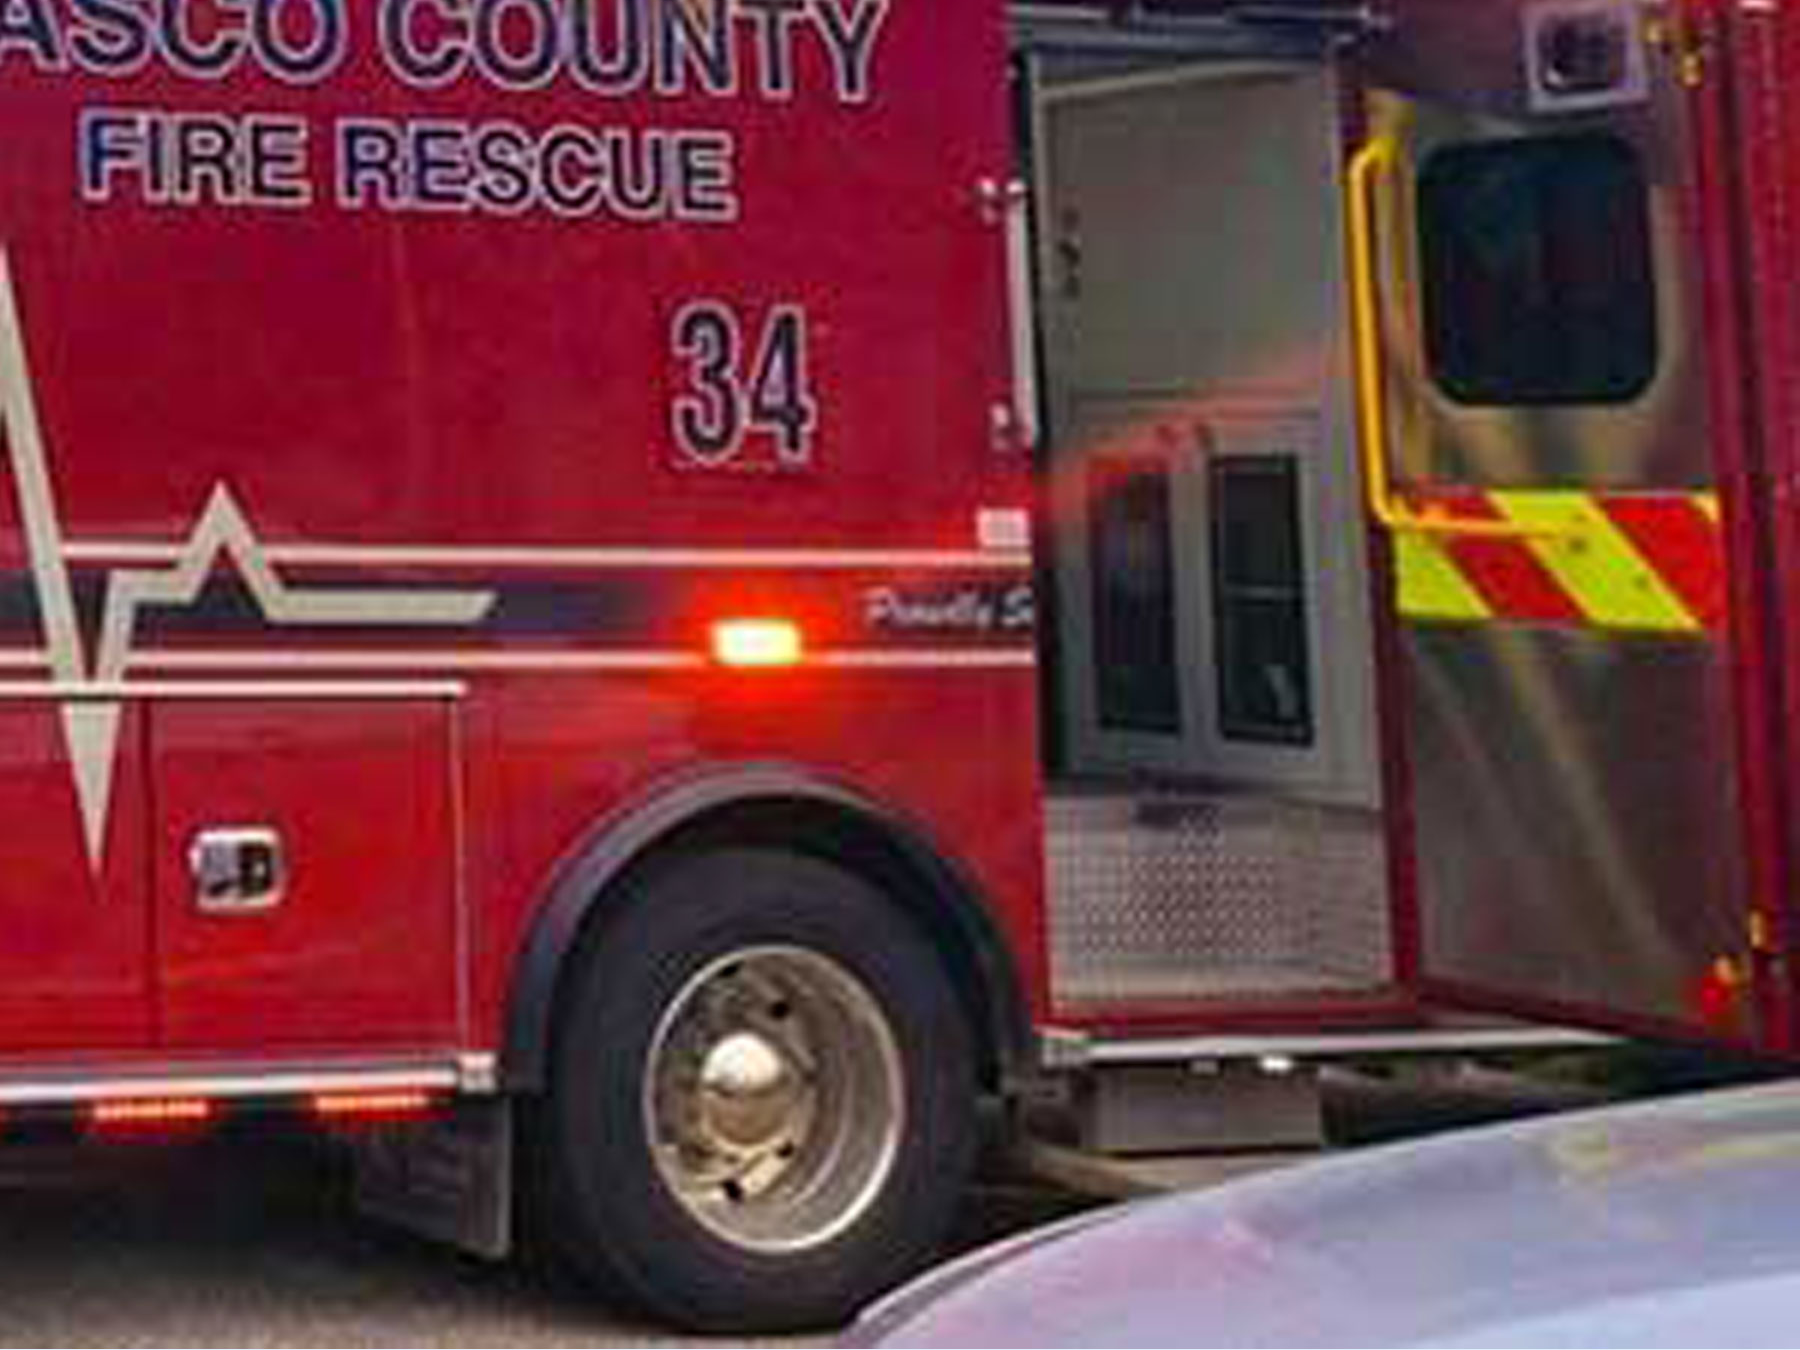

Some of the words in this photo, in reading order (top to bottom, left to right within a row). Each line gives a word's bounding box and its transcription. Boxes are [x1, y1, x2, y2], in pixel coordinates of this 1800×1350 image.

[79, 107, 312, 205] FIRE
[336, 117, 739, 221] RESCUE
[672, 300, 818, 465] 34
